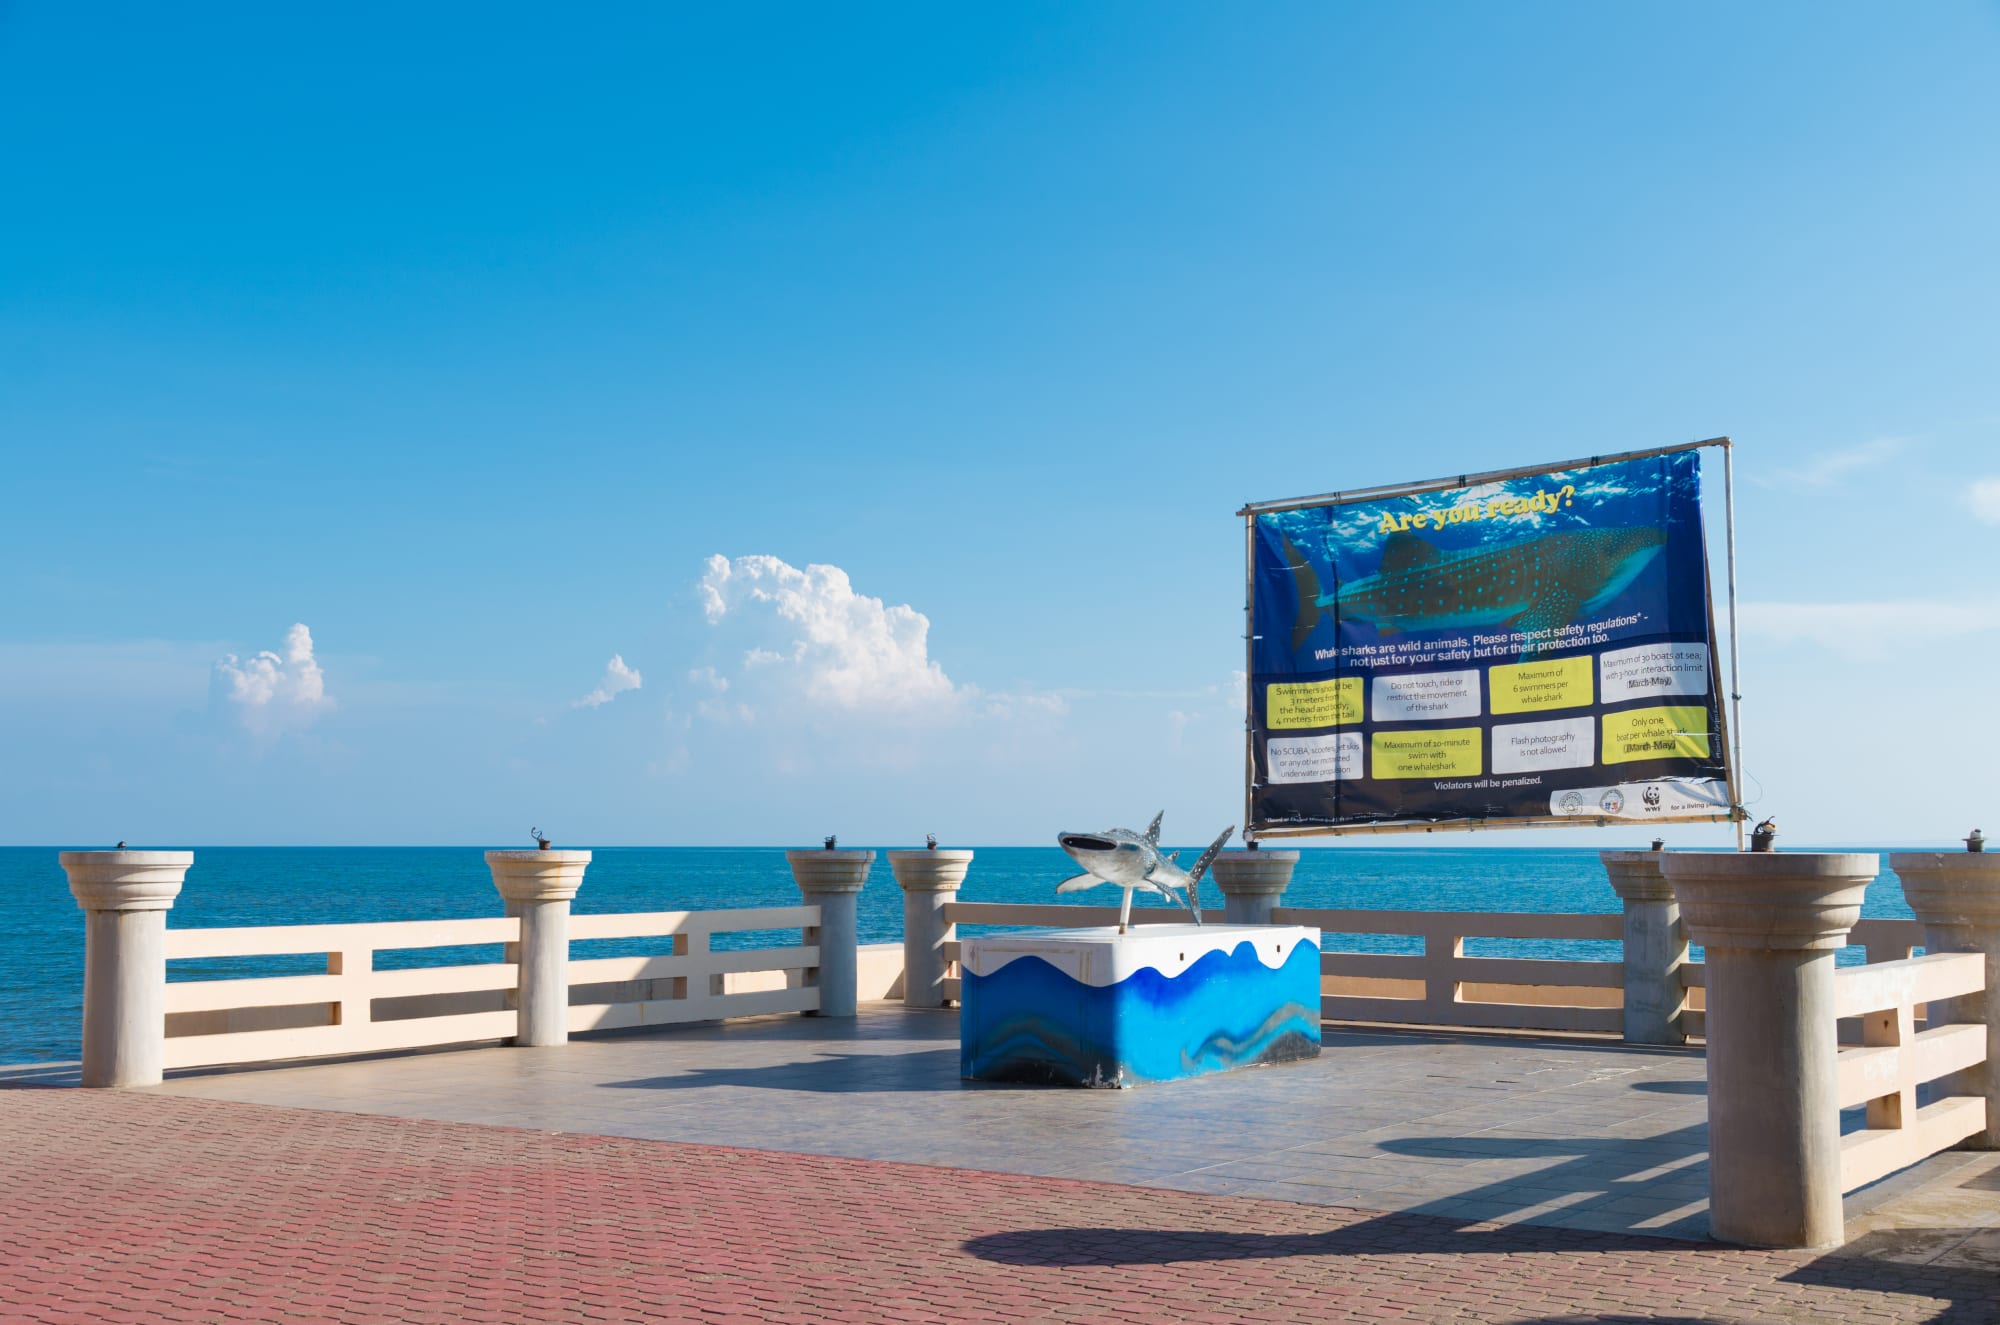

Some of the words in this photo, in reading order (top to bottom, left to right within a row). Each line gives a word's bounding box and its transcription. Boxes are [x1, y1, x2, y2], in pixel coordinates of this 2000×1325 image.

[1379, 511, 1428, 534] Are
[1433, 507, 1480, 531] you
[1487, 485, 1575, 519] ready?
[1314, 647, 1339, 661] Whale
[1341, 645, 1376, 656] sharks
[1379, 643, 1396, 654] are
[1395, 640, 1421, 652] wild
[1424, 636, 1471, 650] animals.
[1473, 634, 1508, 645] Please
[1510, 629, 1551, 645] respect
[1553, 623, 1585, 638] safety
[1350, 654, 1369, 667] not
[1370, 654, 1391, 669] just
[1391, 653, 1406, 665] for
[1409, 652, 1435, 666] your
[1437, 649, 1471, 662] safety
[1473, 646, 1491, 658] but
[1493, 643, 1510, 656] for
[1510, 642, 1535, 654] their
[1537, 635, 1591, 654] protection
[1592, 632, 1610, 643] too.
[1603, 656, 1634, 668] Maximum
[1633, 655, 1641, 663] of
[1641, 655, 1650, 664] 30
[1650, 652, 1673, 661] boats
[1674, 652, 1684, 660] at
[1685, 652, 1702, 660] sea;
[1518, 671, 1555, 681] Maximum
[1555, 667, 1564, 677] of
[1605, 671, 1619, 680] with
[1618, 669, 1639, 680] 3-hour
[1640, 664, 1683, 674] interaction
[1684, 663, 1703, 672] limit
[1275, 686, 1320, 696] Swimmers
[1341, 682, 1353, 690] be
[1390, 681, 1402, 690] Do
[1402, 681, 1415, 689] not
[1415, 680, 1439, 689] touch,
[1439, 678, 1454, 687] ride
[1513, 684, 1519, 693] 6
[1519, 682, 1556, 693] swimmers
[1556, 681, 1568, 690] per
[1290, 698, 1296, 706] 3
[1296, 696, 1324, 705] meters
[1386, 692, 1413, 701] restrict
[1413, 691, 1426, 700] the
[1427, 690, 1467, 699] movement
[1521, 694, 1543, 704] whale
[1543, 692, 1563, 702] shark
[1279, 705, 1294, 714] the
[1295, 704, 1315, 714] head
[1315, 704, 1330, 712] and
[1406, 703, 1415, 712] of
[1415, 703, 1428, 711] the
[1428, 702, 1449, 711] shark
[1275, 717, 1282, 725] 4
[1282, 716, 1312, 724] meters
[1313, 713, 1329, 722] from
[1341, 709, 1355, 719] tail
[1631, 717, 1648, 727] Only
[1648, 717, 1665, 725] one
[1511, 735, 1530, 745] Flash
[1530, 732, 1576, 745] photography
[1616, 733, 1629, 742] boat
[1629, 732, 1640, 741] per
[1641, 728, 1665, 738] whale
[1270, 747, 1282, 756] No
[1282, 746, 1310, 756] SCUBA,
[1311, 745, 1335, 754] scootes
[1346, 743, 1360, 751] skis
[1384, 741, 1423, 749] Maximum
[1423, 739, 1432, 748] of
[1433, 739, 1471, 748] 10-minute
[1408, 751, 1428, 760] swim
[1429, 750, 1447, 759] with
[1520, 749, 1526, 757] is
[1526, 748, 1538, 756] not
[1539, 745, 1567, 755] allowed
[1288, 759, 1301, 768] any
[1301, 757, 1319, 766] other
[1281, 769, 1319, 778] underwater
[1319, 767, 1351, 777] propsion
[1434, 781, 1473, 790] Violators
[1473, 779, 1488, 788] will
[1489, 779, 1501, 788] be
[1502, 776, 1542, 789] penalized.
[1686, 802, 1705, 810] living
